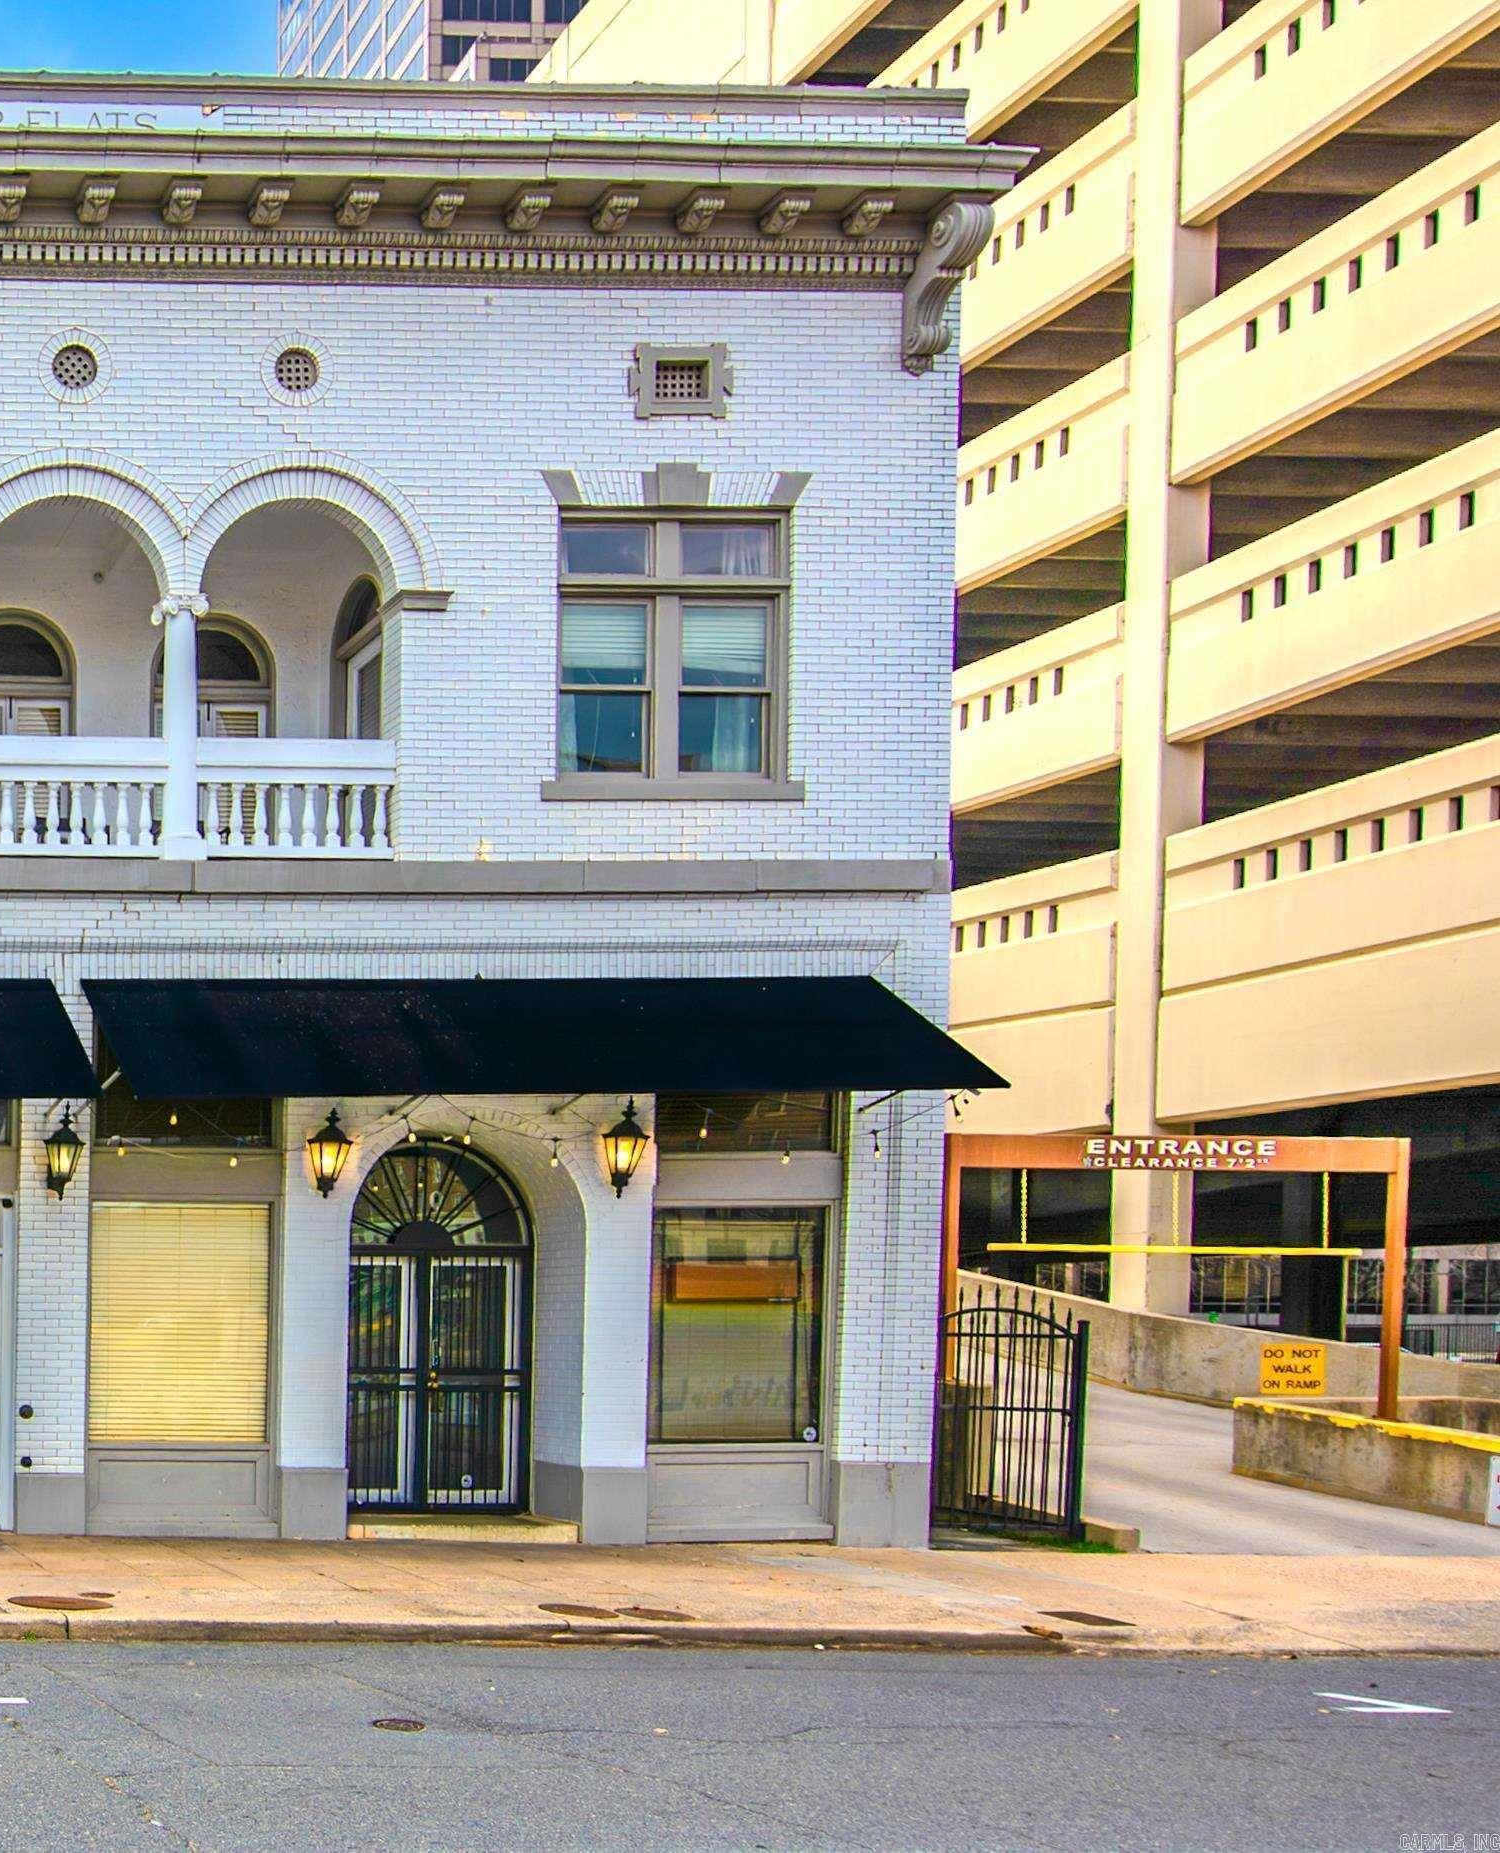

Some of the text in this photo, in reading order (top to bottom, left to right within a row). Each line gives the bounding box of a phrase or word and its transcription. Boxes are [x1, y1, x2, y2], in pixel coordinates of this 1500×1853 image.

[1086, 1139, 1277, 1156] ENTRANCE
[1094, 1157, 1218, 1169] CLEARANCE
[1263, 1349, 1322, 1359] DO NOT
[1272, 1364, 1312, 1374] WALK
[1263, 1379, 1322, 1390] ON RAMP
